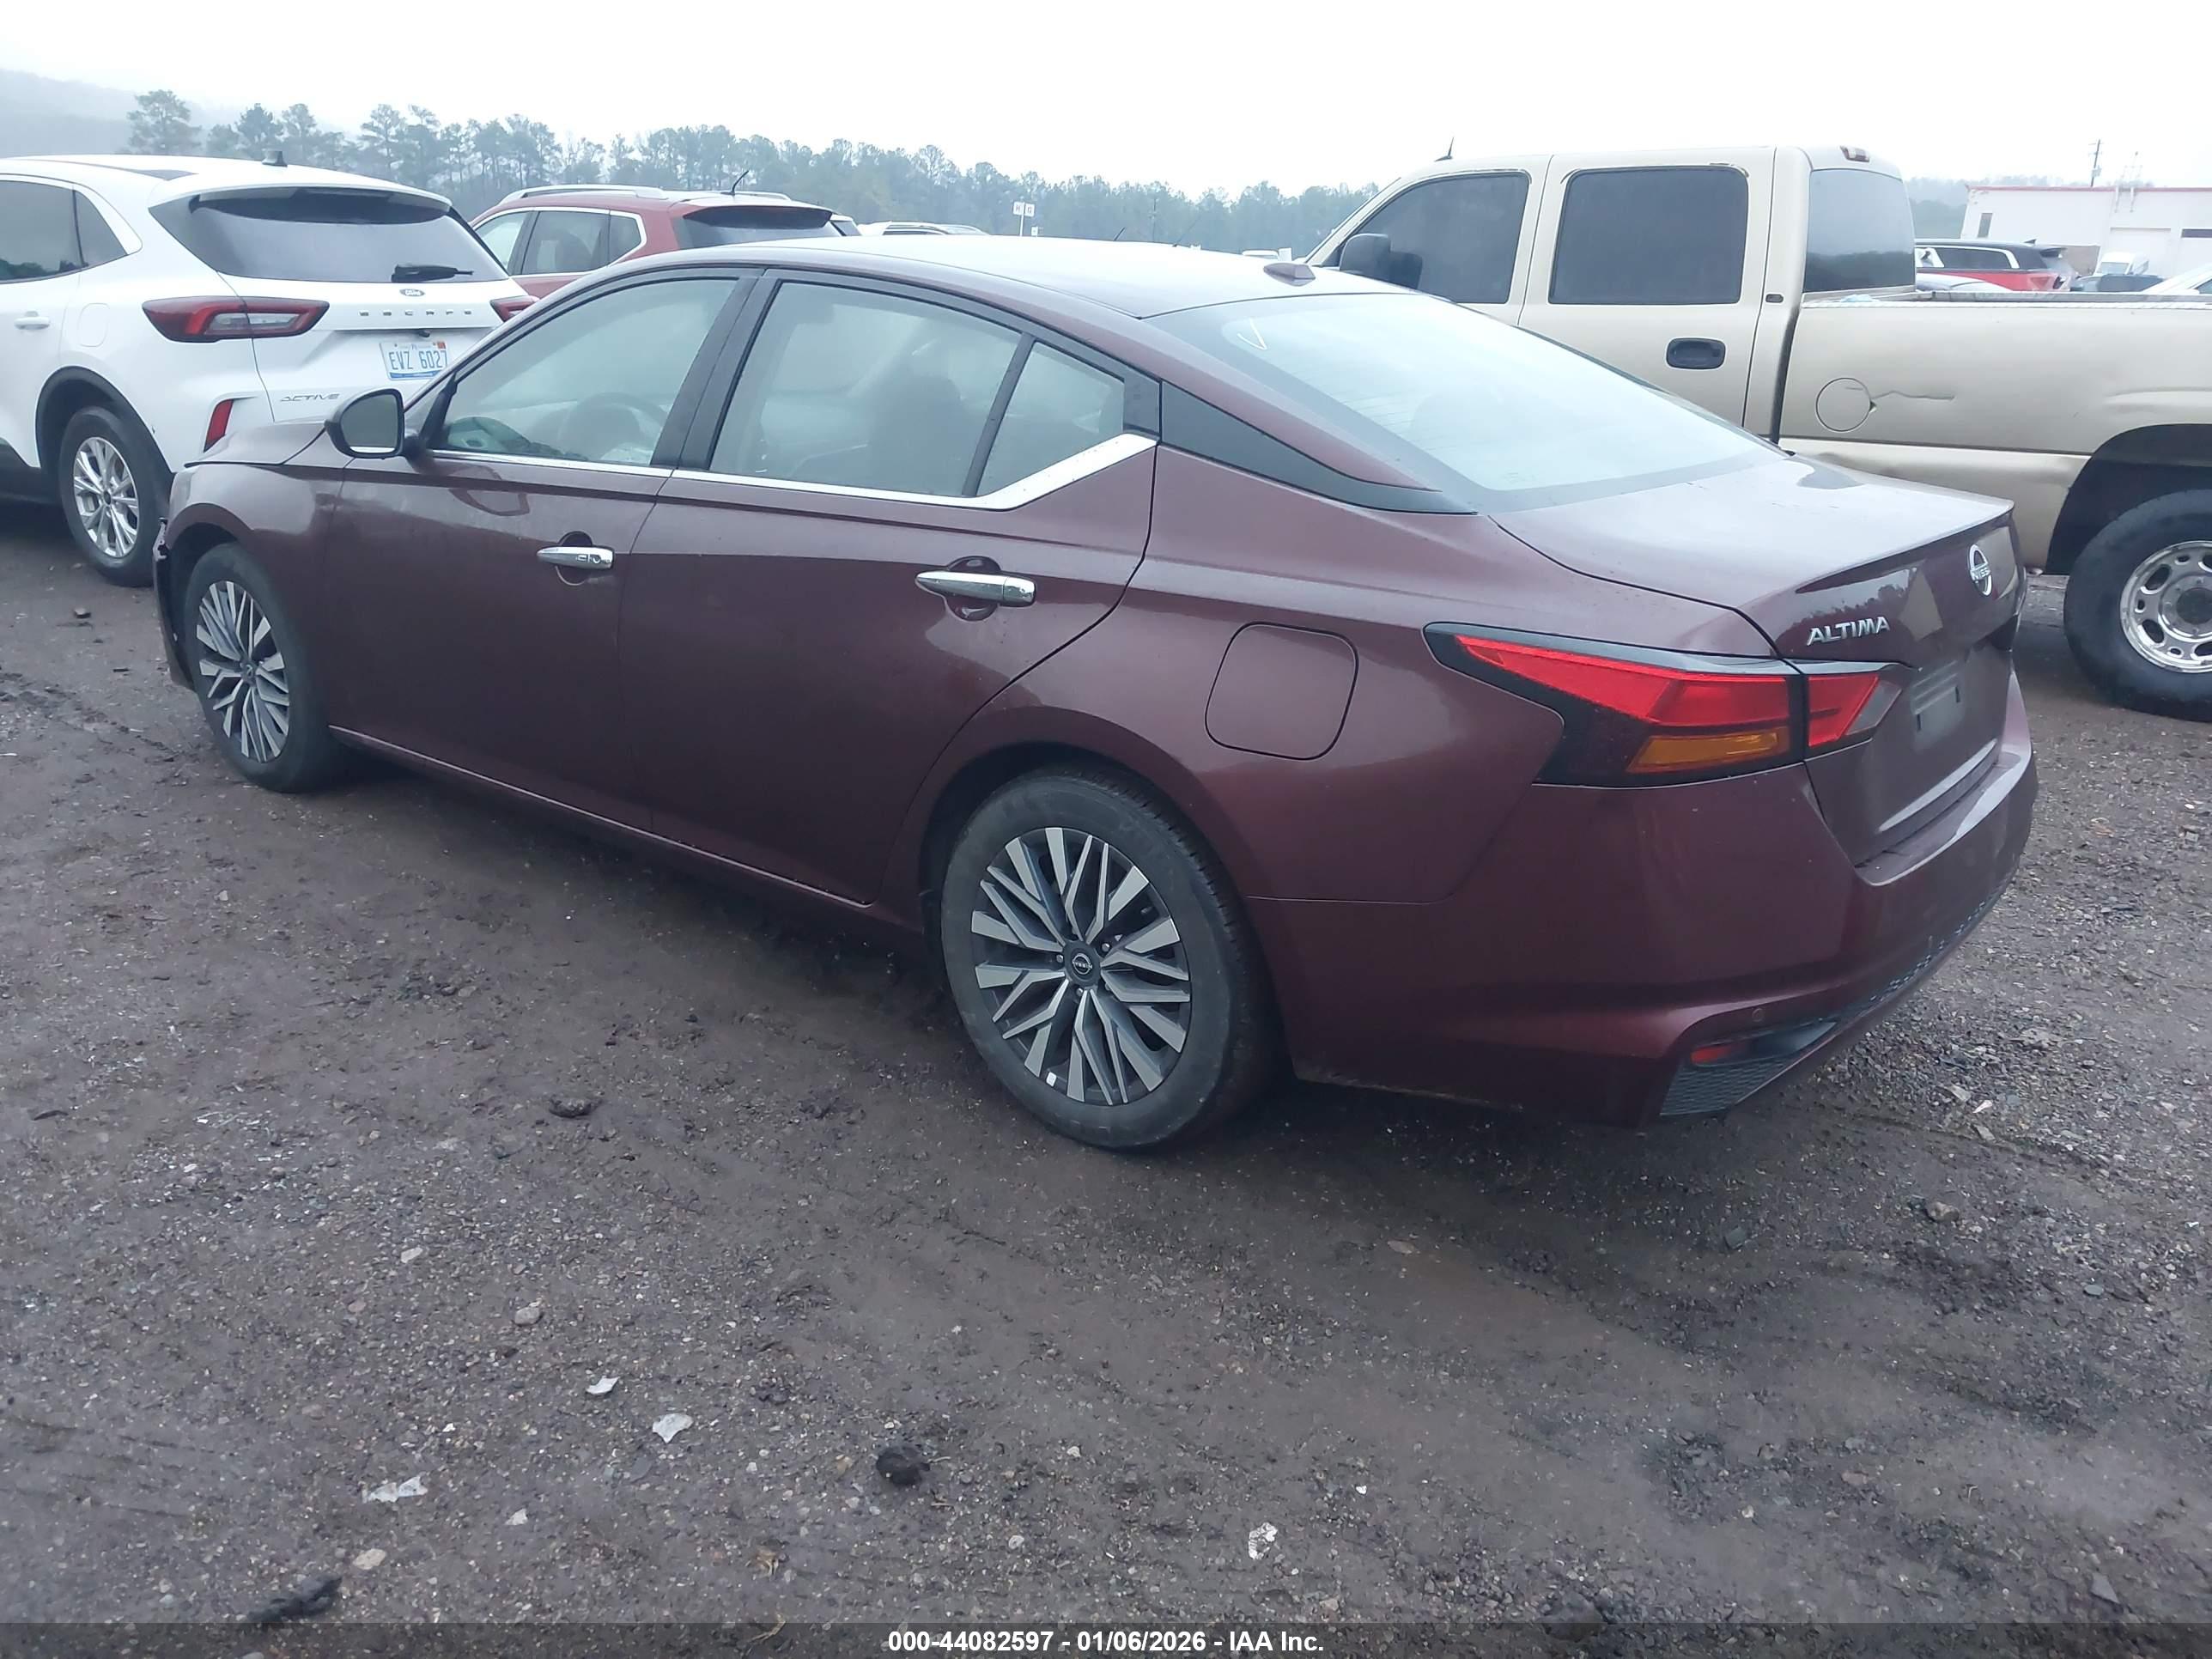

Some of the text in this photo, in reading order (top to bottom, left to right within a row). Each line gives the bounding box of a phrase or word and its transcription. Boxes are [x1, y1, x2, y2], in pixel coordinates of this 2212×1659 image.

[388, 349, 448, 370] EVZ 6027
[1806, 616, 1891, 646] ALTIMA
